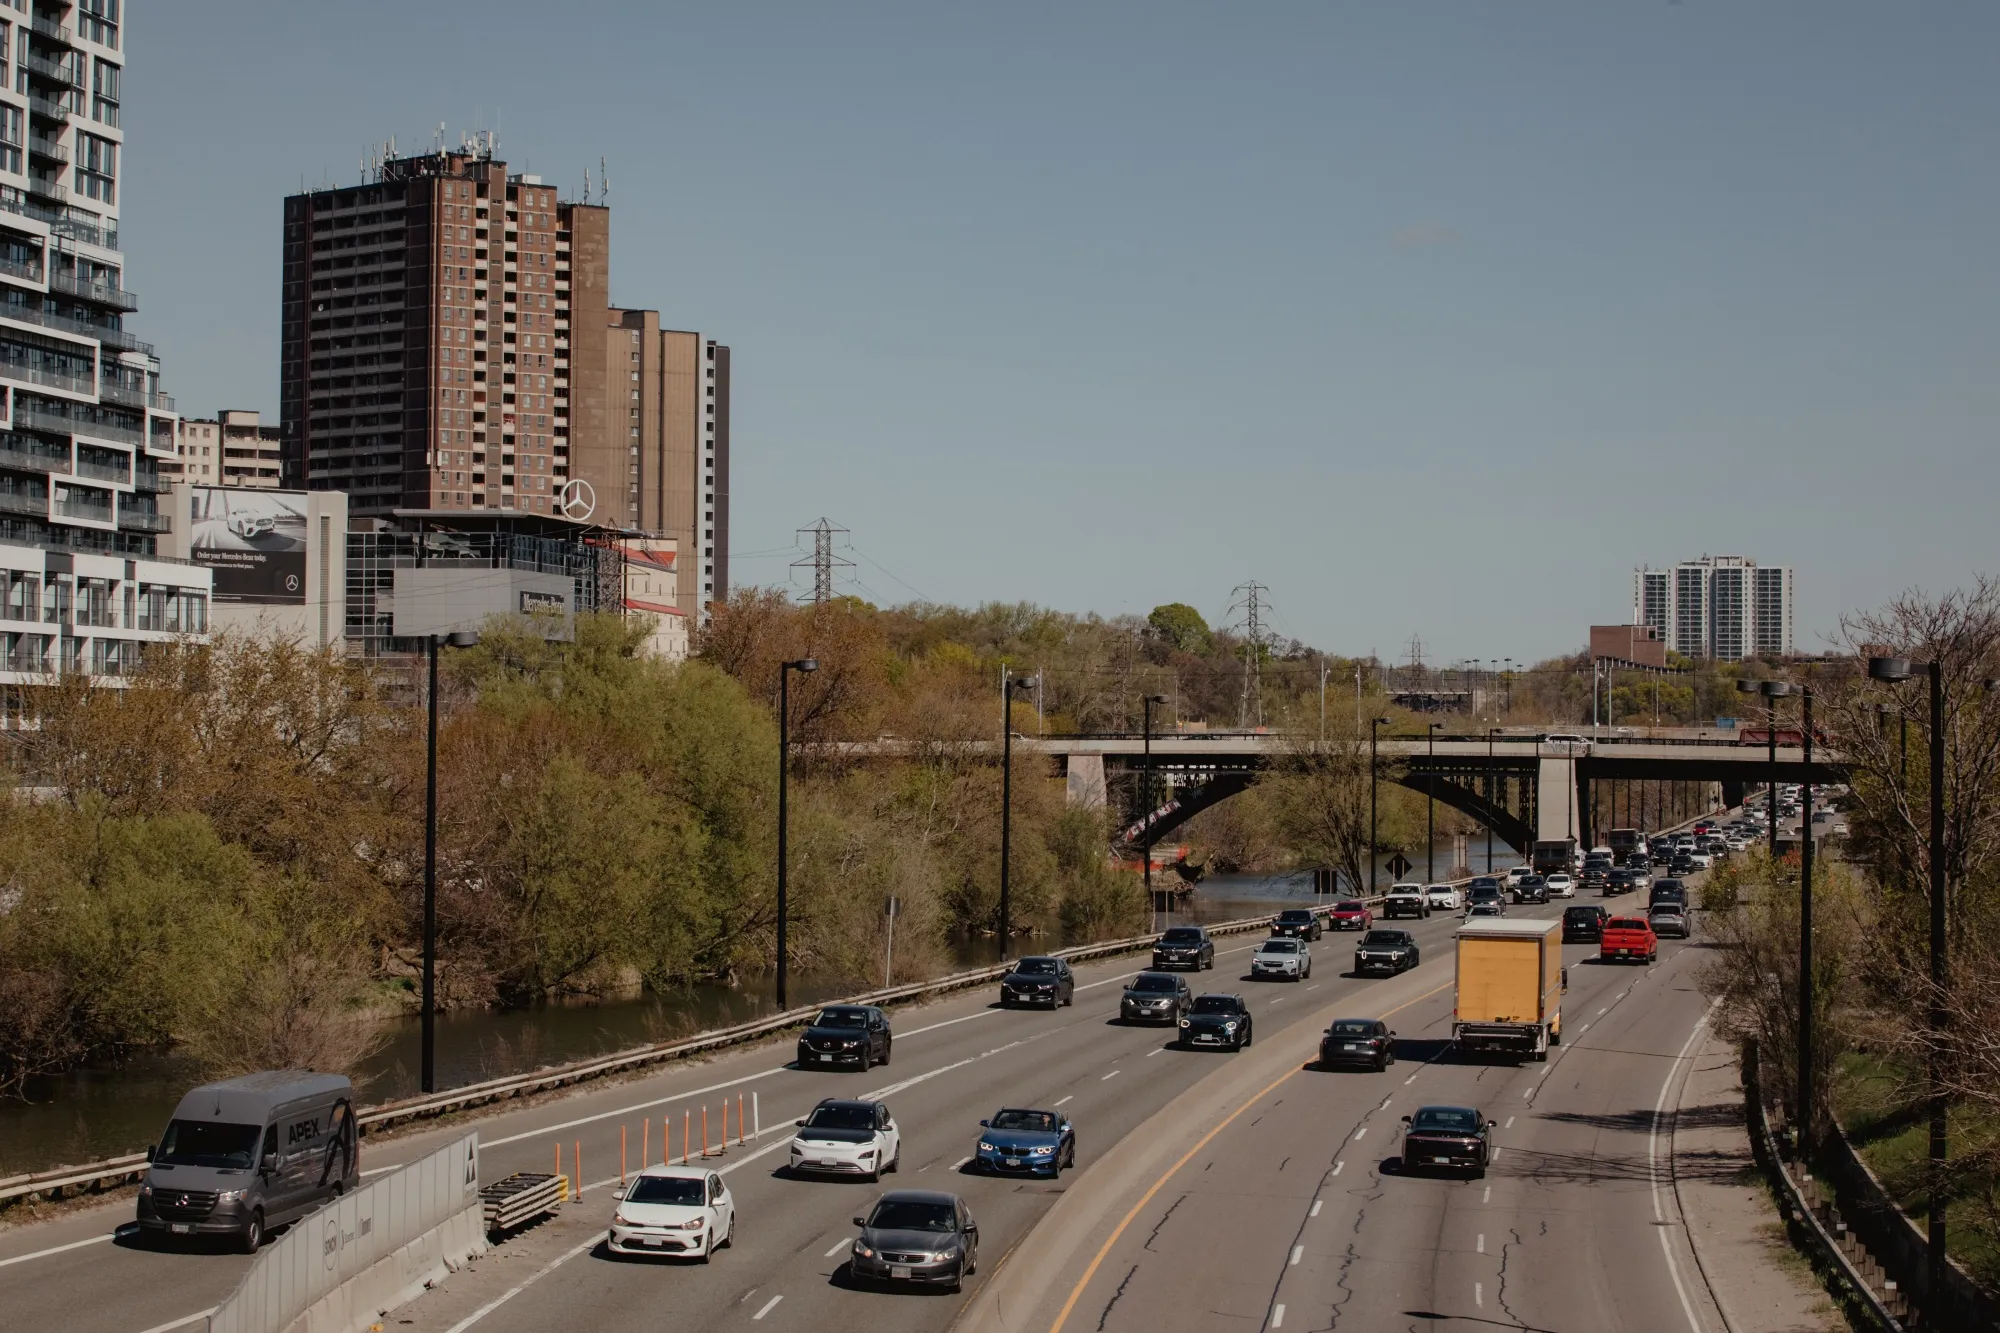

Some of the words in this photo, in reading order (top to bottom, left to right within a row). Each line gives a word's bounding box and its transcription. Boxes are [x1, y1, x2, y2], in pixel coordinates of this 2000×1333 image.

[197, 551, 210, 559] Order
[221, 552, 254, 561] Mercedes-Benz
[254, 554, 267, 563] today.
[288, 1117, 320, 1145] APEX
